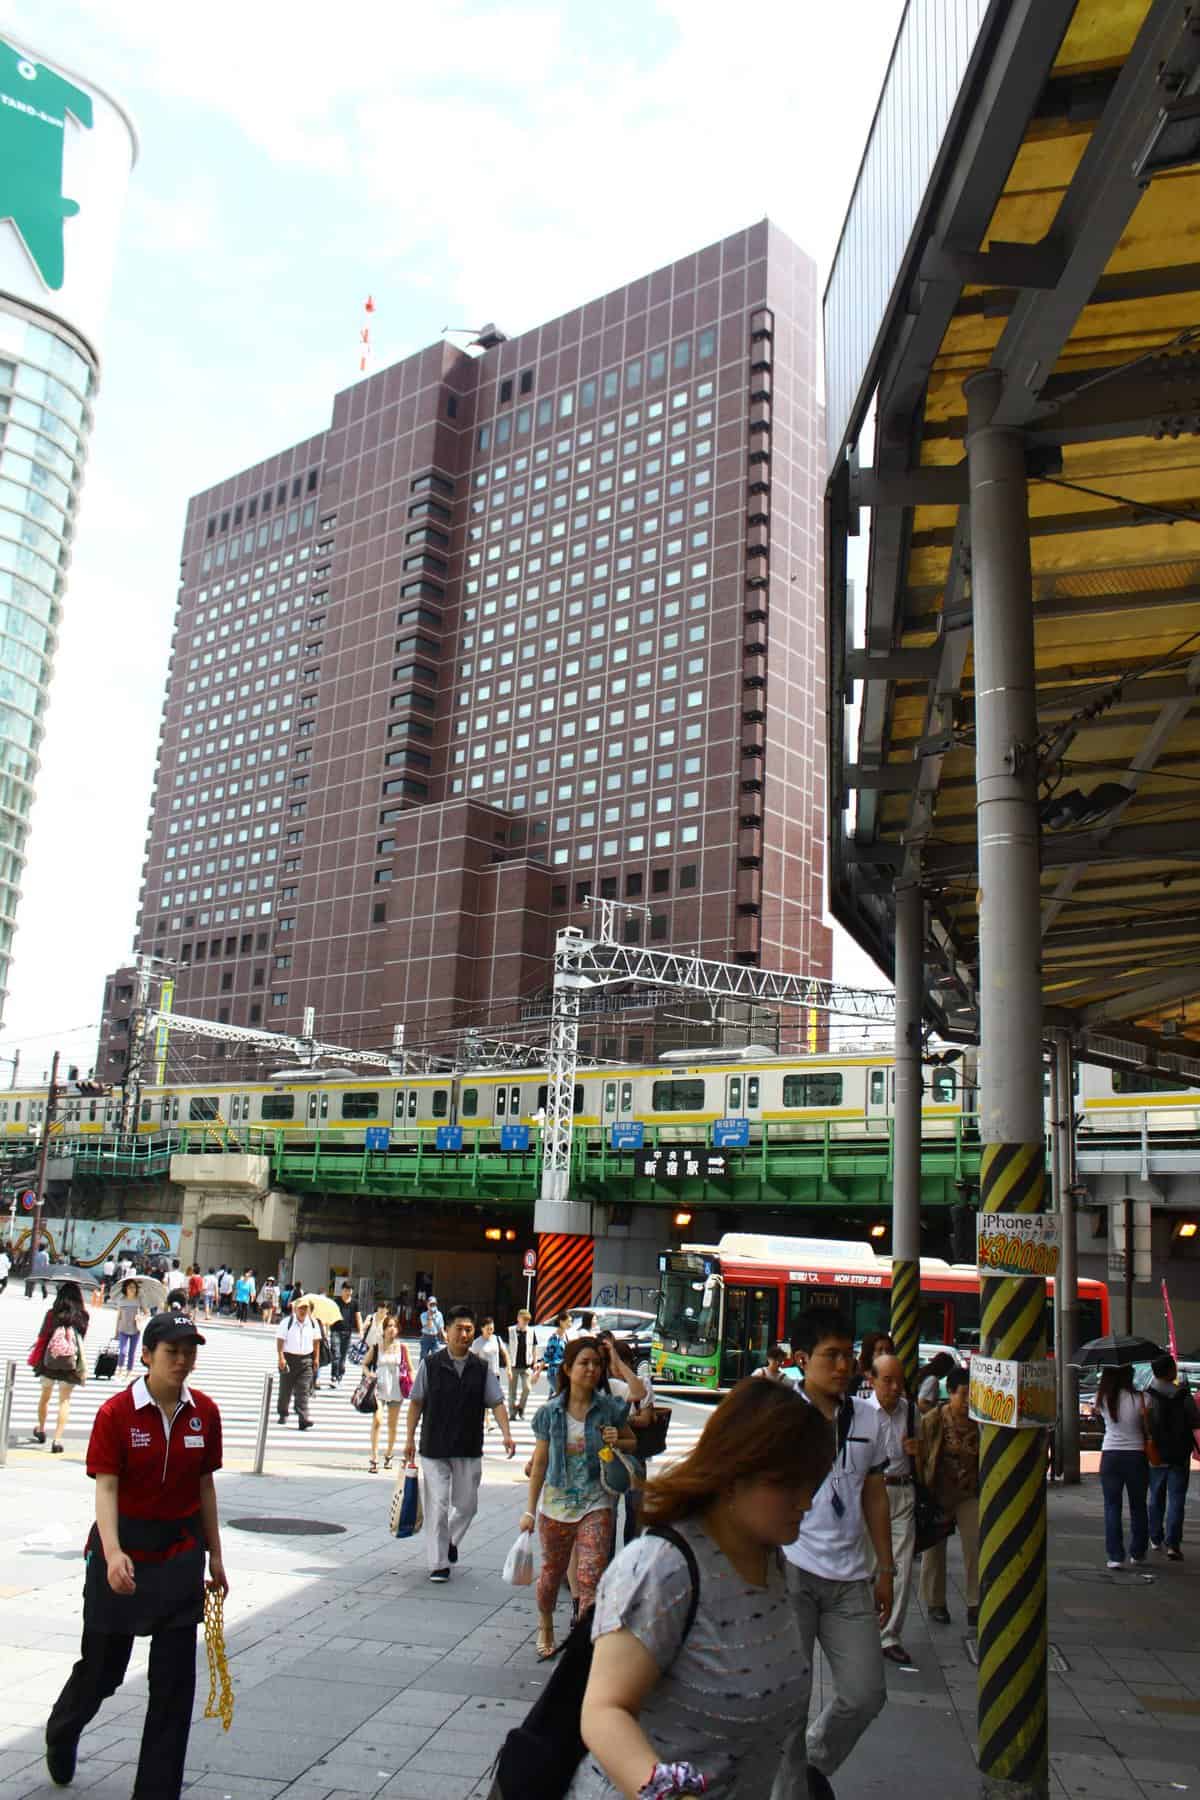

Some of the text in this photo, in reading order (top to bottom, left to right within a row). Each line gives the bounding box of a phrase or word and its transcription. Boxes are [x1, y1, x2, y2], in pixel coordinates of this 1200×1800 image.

[644, 1160, 699, 1176] 新宿駅
[983, 1214, 1033, 1229] iPhone
[1035, 1216, 1043, 1229] 4
[834, 1273, 881, 1284] NON STEP BUS
[994, 1362, 1001, 1375] 4
